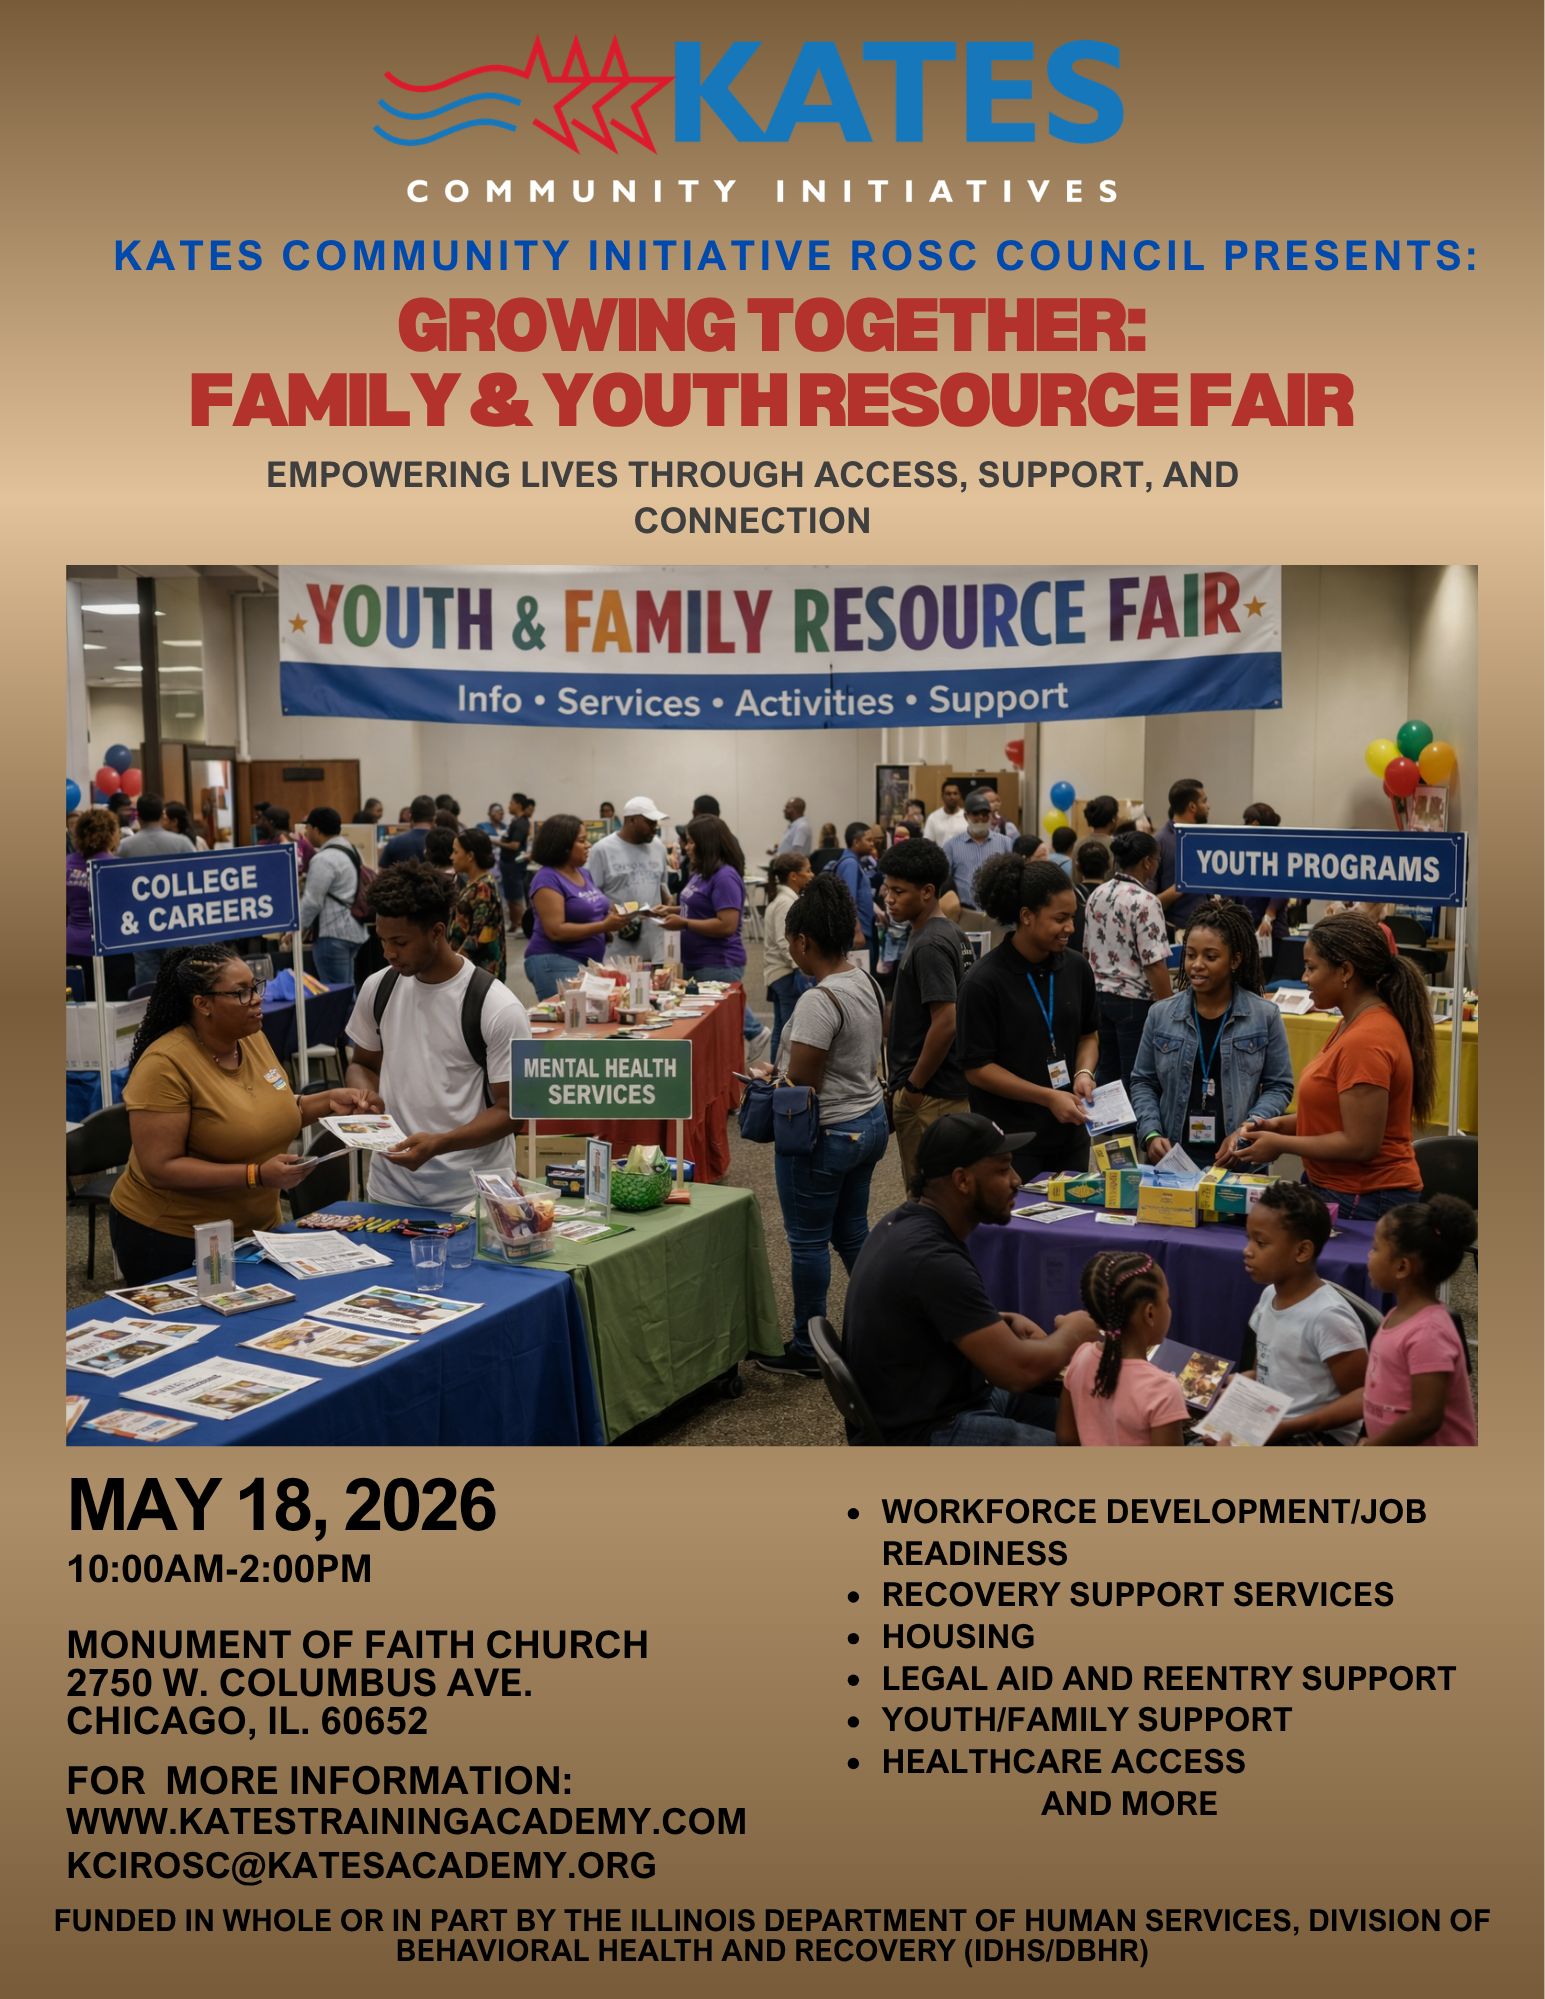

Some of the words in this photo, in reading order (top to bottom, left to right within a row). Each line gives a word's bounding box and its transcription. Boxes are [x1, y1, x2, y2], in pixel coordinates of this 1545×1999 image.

[674, 39, 1125, 144] KATES
[406, 179, 737, 203] COMMUNITY
[776, 179, 1118, 203] INITIATIVES
[115, 239, 263, 272] KATES
[282, 239, 570, 272] COMMUNITY
[589, 239, 831, 271] INITIATIVE
[851, 239, 977, 272] ROSC
[996, 239, 1205, 272] COUNCIL
[1225, 239, 1475, 272] PRESENTS:
[398, 296, 736, 353] GROWING
[746, 296, 1146, 353] TOGETHER:
[191, 372, 462, 427] FAMILY
[469, 371, 534, 428] &
[541, 371, 788, 428] YOUTH
[799, 371, 1179, 428] RESOURCE
[1190, 372, 1355, 427] FAIR
[267, 460, 510, 489] EMPOWERING
[521, 460, 618, 489] LIVES
[627, 460, 804, 489] THROUGH
[813, 460, 967, 494] ACCESS,
[978, 460, 1153, 494] SUPPORT,
[1162, 460, 1239, 488] AND
[634, 506, 870, 535] CONNECTION
[306, 583, 493, 650] YOUTH
[512, 595, 546, 651] &
[564, 589, 773, 654] FAMILY
[794, 579, 1086, 653] RESOURCE
[1109, 571, 1241, 642] FAIR
[458, 684, 522, 714] Info
[557, 687, 701, 717] Services
[735, 686, 894, 718] Activities
[929, 682, 1069, 719] Support
[1196, 849, 1278, 877] YOUTH
[1287, 852, 1440, 883] PROGRAMS
[131, 865, 258, 901] COLLEGE
[120, 911, 140, 936] &
[148, 894, 274, 932] CAREERS
[524, 1058, 600, 1078] MENTAL
[605, 1058, 677, 1078] HEALTH
[548, 1084, 656, 1105] SERVICES
[70, 1477, 224, 1531] MAY
[239, 1476, 327, 1543] 18,
[344, 1477, 497, 1532] 2026
[881, 1498, 1097, 1525] WORKFORCE
[1107, 1498, 1427, 1525] DEVELOPMENT/JOB
[68, 1553, 371, 1584] 10:00AM-2:00PM
[883, 1540, 1068, 1567] READINESS
[883, 1581, 1062, 1608] RECOVERY
[1069, 1581, 1225, 1608] SUPPORT
[1233, 1581, 1394, 1608] SERVICES
[68, 1629, 292, 1660] MONUMENT
[302, 1629, 354, 1660] OF
[365, 1629, 474, 1659] FAITH
[486, 1629, 648, 1660] CHURCH
[883, 1623, 1035, 1650] HOUSING
[66, 1667, 153, 1698] 2750
[162, 1667, 208, 1697] W.
[219, 1667, 437, 1698] COLUMBUS
[446, 1667, 532, 1697] AVE.
[883, 1665, 989, 1692] LEGAL
[996, 1665, 1054, 1691] AID
[1061, 1665, 1133, 1691] AND
[1143, 1665, 1294, 1691] REENTRY
[1301, 1665, 1457, 1692] SUPPORT
[66, 1705, 256, 1741] CHICAGO,
[269, 1705, 309, 1735] IL.
[321, 1705, 428, 1736] 60652
[881, 1706, 1130, 1733] YOUTH/FAMILY
[1137, 1706, 1293, 1733] SUPPORT
[883, 1748, 1102, 1775] HEALTHCARE
[1110, 1748, 1246, 1775] ACCESS
[68, 1765, 146, 1796] FOR
[167, 1765, 278, 1796] MORE
[290, 1765, 571, 1796] INFORMATION:
[1040, 1790, 1112, 1816] AND
[1122, 1790, 1218, 1817] MORE
[65, 1807, 746, 1836] WWW.KATESTRAININGACADEMY.COM
[68, 1851, 656, 1887] KCIROSC@KATESACADEMY.ORG
[55, 1908, 177, 1933] FUNDED
[185, 1908, 214, 1932] IN
[222, 1908, 332, 1933] WHOLE
[340, 1908, 385, 1933] OR
[393, 1908, 421, 1932] IN
[431, 1908, 508, 1932] PART
[517, 1908, 557, 1932] BY
[563, 1908, 622, 1932] THE
[631, 1908, 756, 1933] ILLINOIS
[765, 1908, 968, 1932] DEPARTMENT
[975, 1908, 1016, 1933] OF
[1025, 1908, 1136, 1933] HUMAN
[1145, 1908, 1300, 1937] SERVICES,
[1309, 1908, 1441, 1933] DIVISION
[1449, 1908, 1491, 1933] OF
[397, 1938, 590, 1963] BEHAVIORAL
[598, 1938, 713, 1962] HEALTH
[720, 1938, 786, 1962] AND
[795, 1938, 957, 1963] RECOVERY
[964, 1938, 1149, 1968] (IDHS/DBHR)
